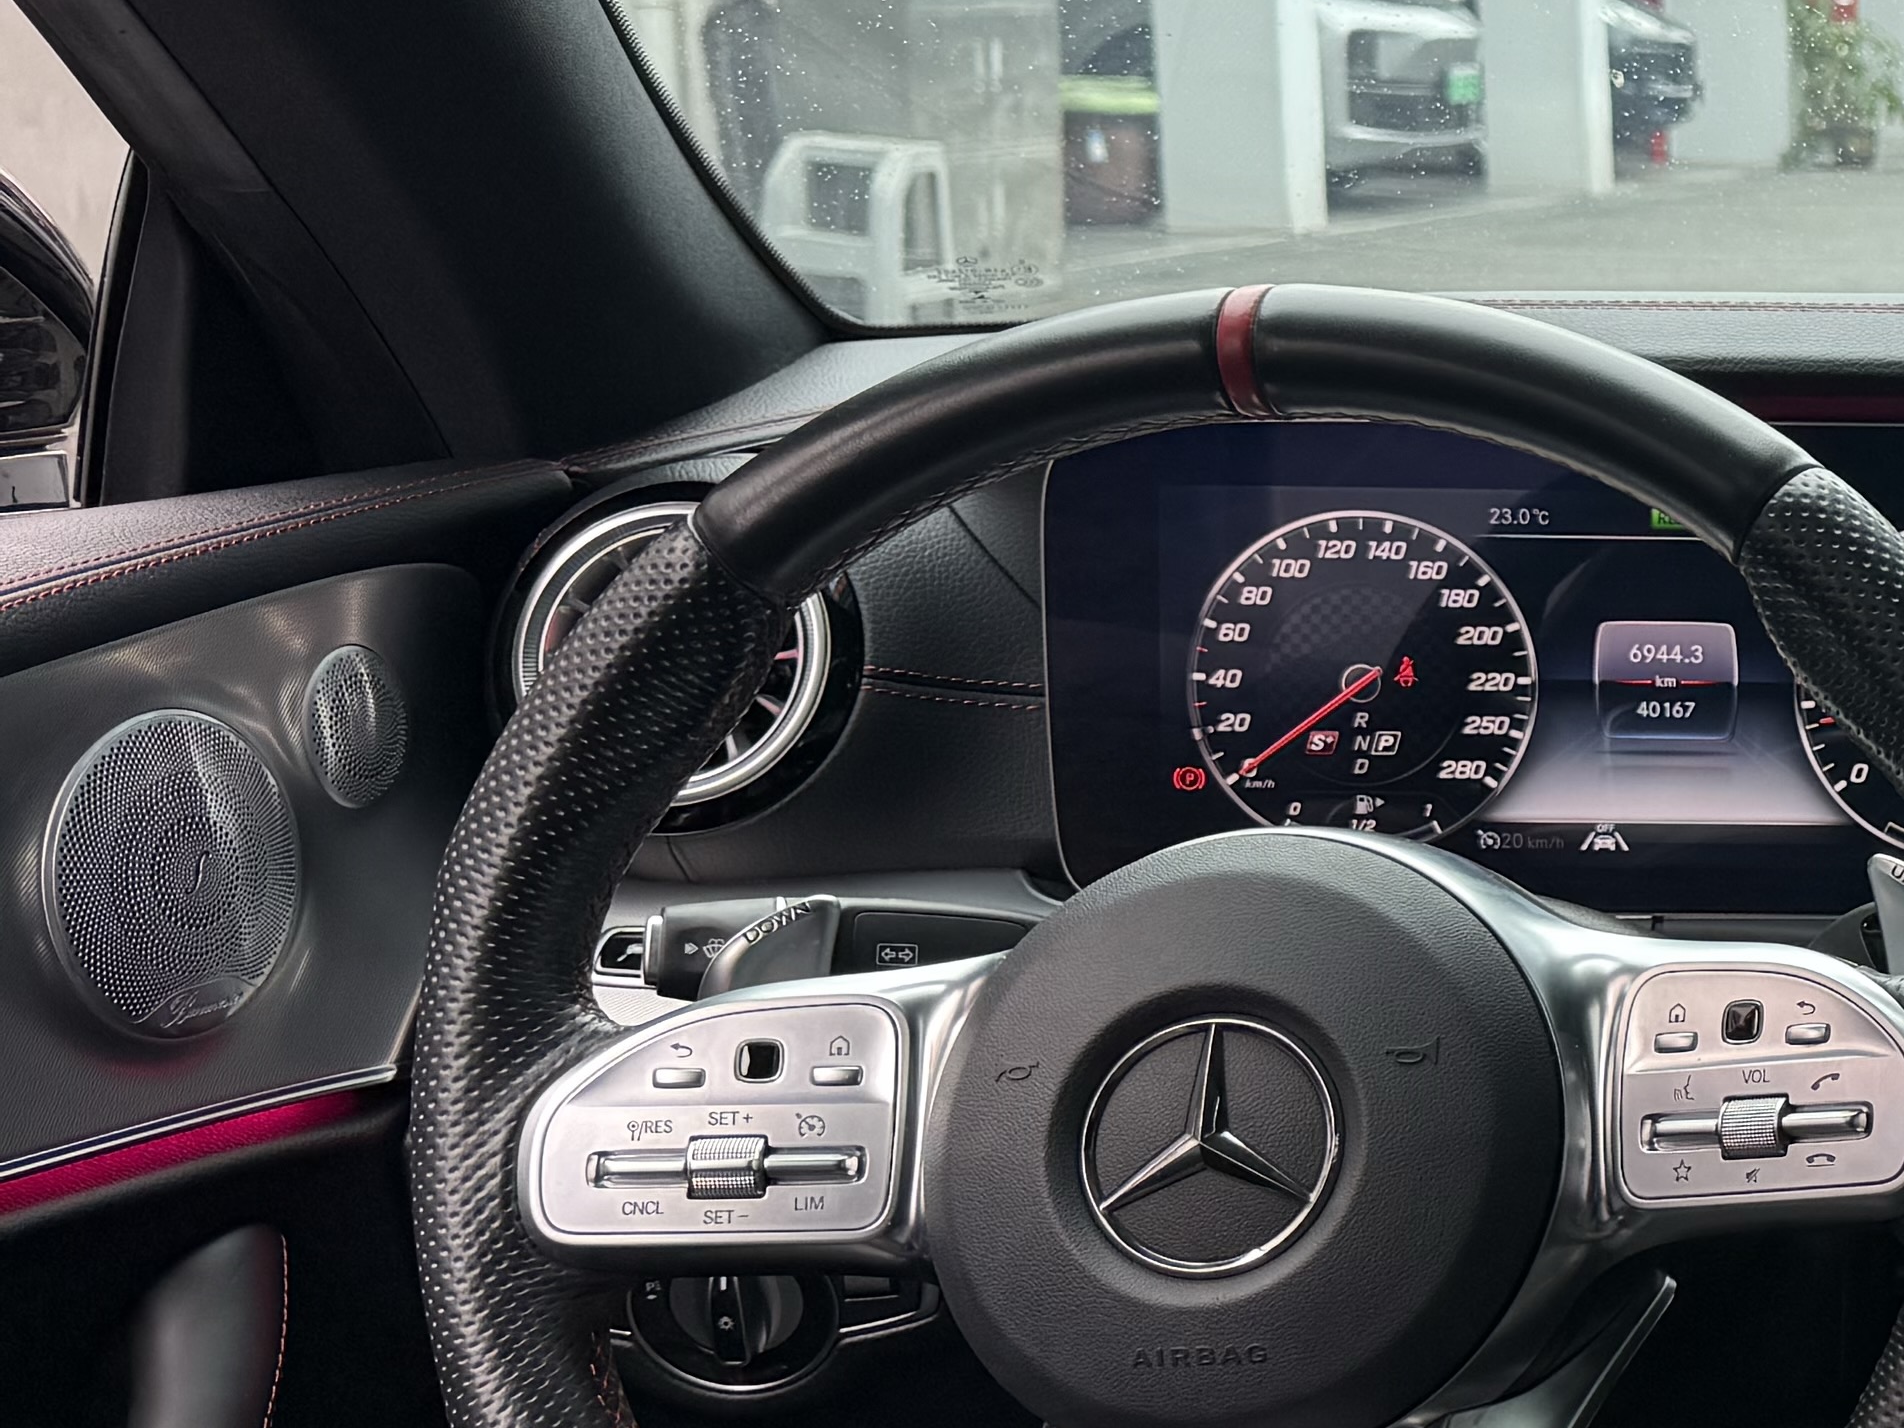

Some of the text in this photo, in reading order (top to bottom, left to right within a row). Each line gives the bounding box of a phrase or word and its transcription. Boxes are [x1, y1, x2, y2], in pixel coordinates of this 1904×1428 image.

[1489, 508, 1550, 526] 23.0°C
[1317, 540, 1357, 559] 120
[1367, 541, 1407, 560] 140
[1271, 559, 1310, 578] 100
[1408, 561, 1448, 580] 160
[1239, 586, 1273, 605] 80
[1440, 589, 1480, 608] 180
[1217, 623, 1251, 642] 60
[1455, 626, 1503, 645] 200
[1629, 644, 1704, 664] 6944.3
[1208, 669, 1242, 688] 40
[1467, 672, 1516, 691] 220
[1655, 675, 1677, 688] km
[1636, 701, 1696, 718] 40167
[1216, 713, 1251, 732] 20
[1354, 712, 1369, 728] R
[1461, 716, 1510, 735] 250
[1354, 736, 1395, 751] N P
[1354, 758, 1369, 774] D
[1437, 760, 1487, 779] 280
[1850, 763, 1869, 783] 0
[1244, 778, 1275, 789] km/h
[1288, 801, 1302, 816] 0
[1423, 803, 1434, 818] 1
[1501, 834, 1564, 850] 20 km/h
[743, 900, 813, 944] DOWN
[1741, 1068, 1771, 1084] VOL
[621, 1200, 665, 1217] CNCL
[794, 1196, 825, 1212] LIM
[1133, 1344, 1269, 1369] AIRBAG
